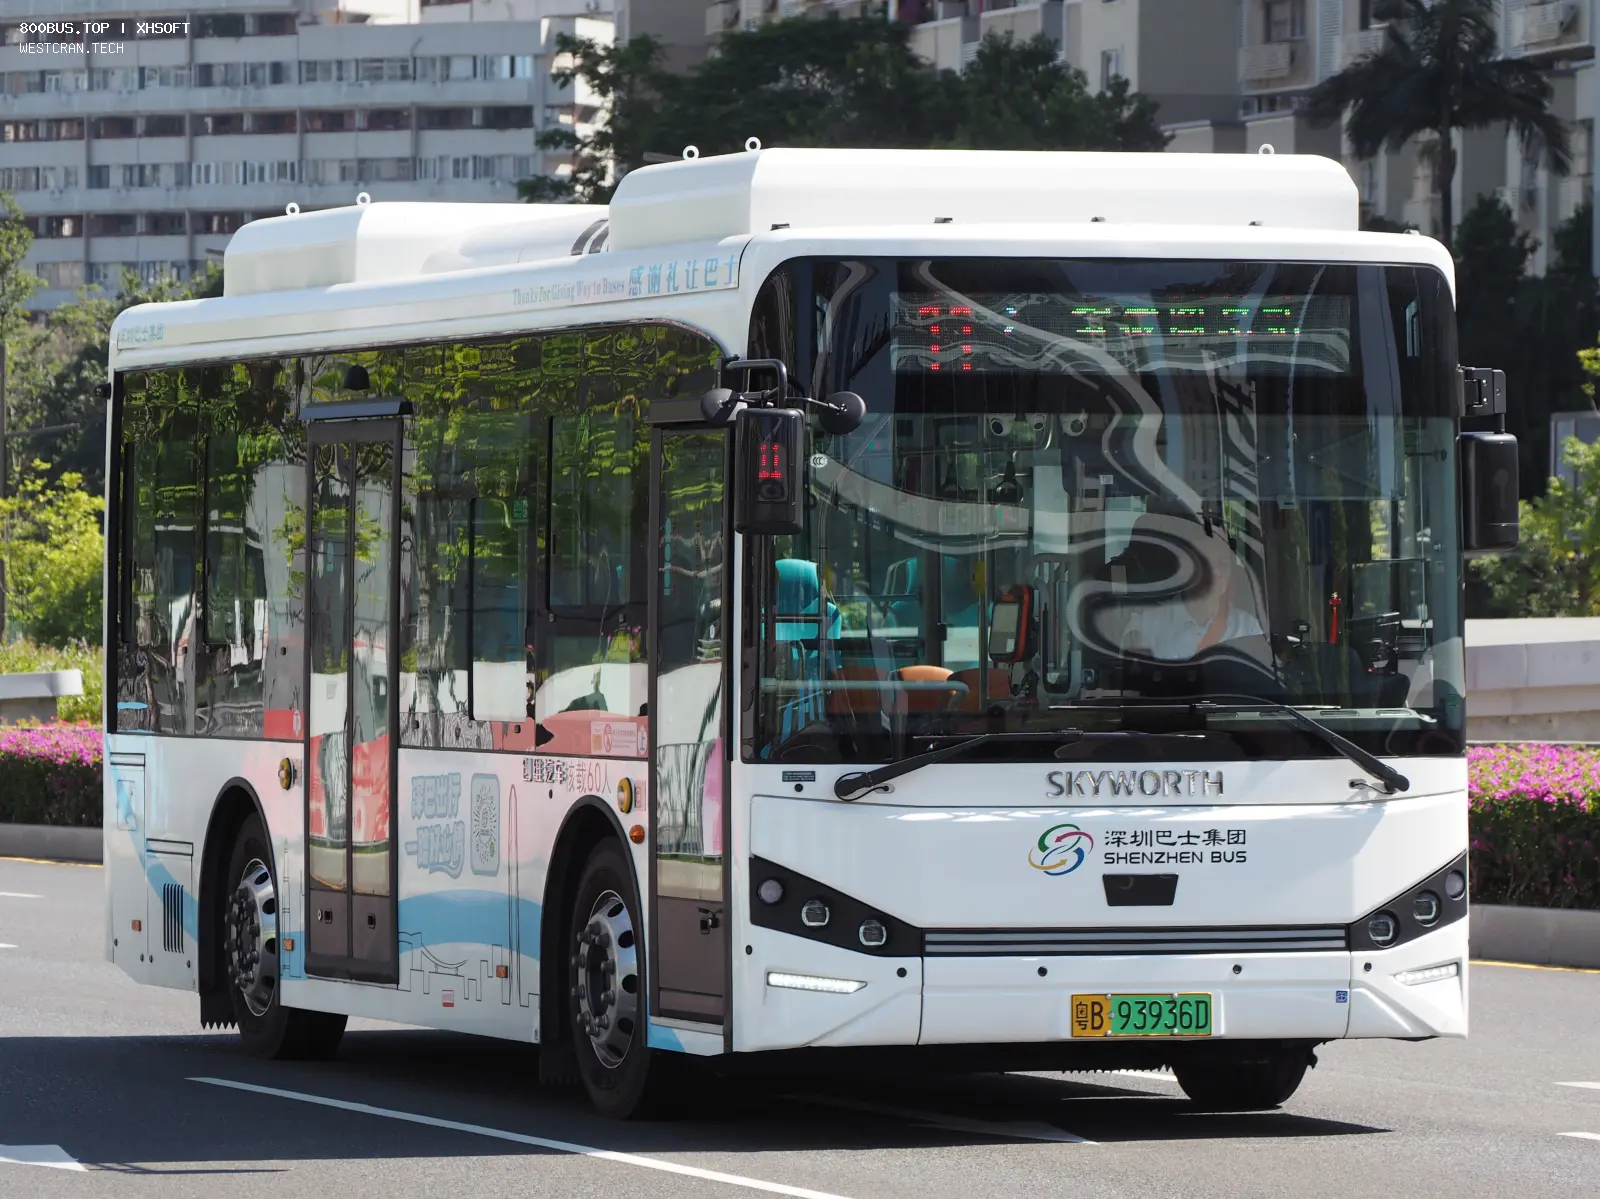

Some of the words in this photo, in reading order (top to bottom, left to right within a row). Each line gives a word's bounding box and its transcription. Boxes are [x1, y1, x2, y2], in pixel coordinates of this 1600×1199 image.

[628, 254, 738, 297] 感谢礼让巴士
[513, 287, 538, 306] Thanks
[551, 283, 575, 302] Giving
[577, 279, 592, 300] Way
[592, 279, 601, 295] to
[602, 277, 625, 295] Buses
[1045, 770, 1225, 798] SKYWORTH
[1104, 829, 1248, 847] 深圳巴士集团
[1104, 851, 1203, 865] SHENZHEN
[1210, 850, 1248, 864] BUS
